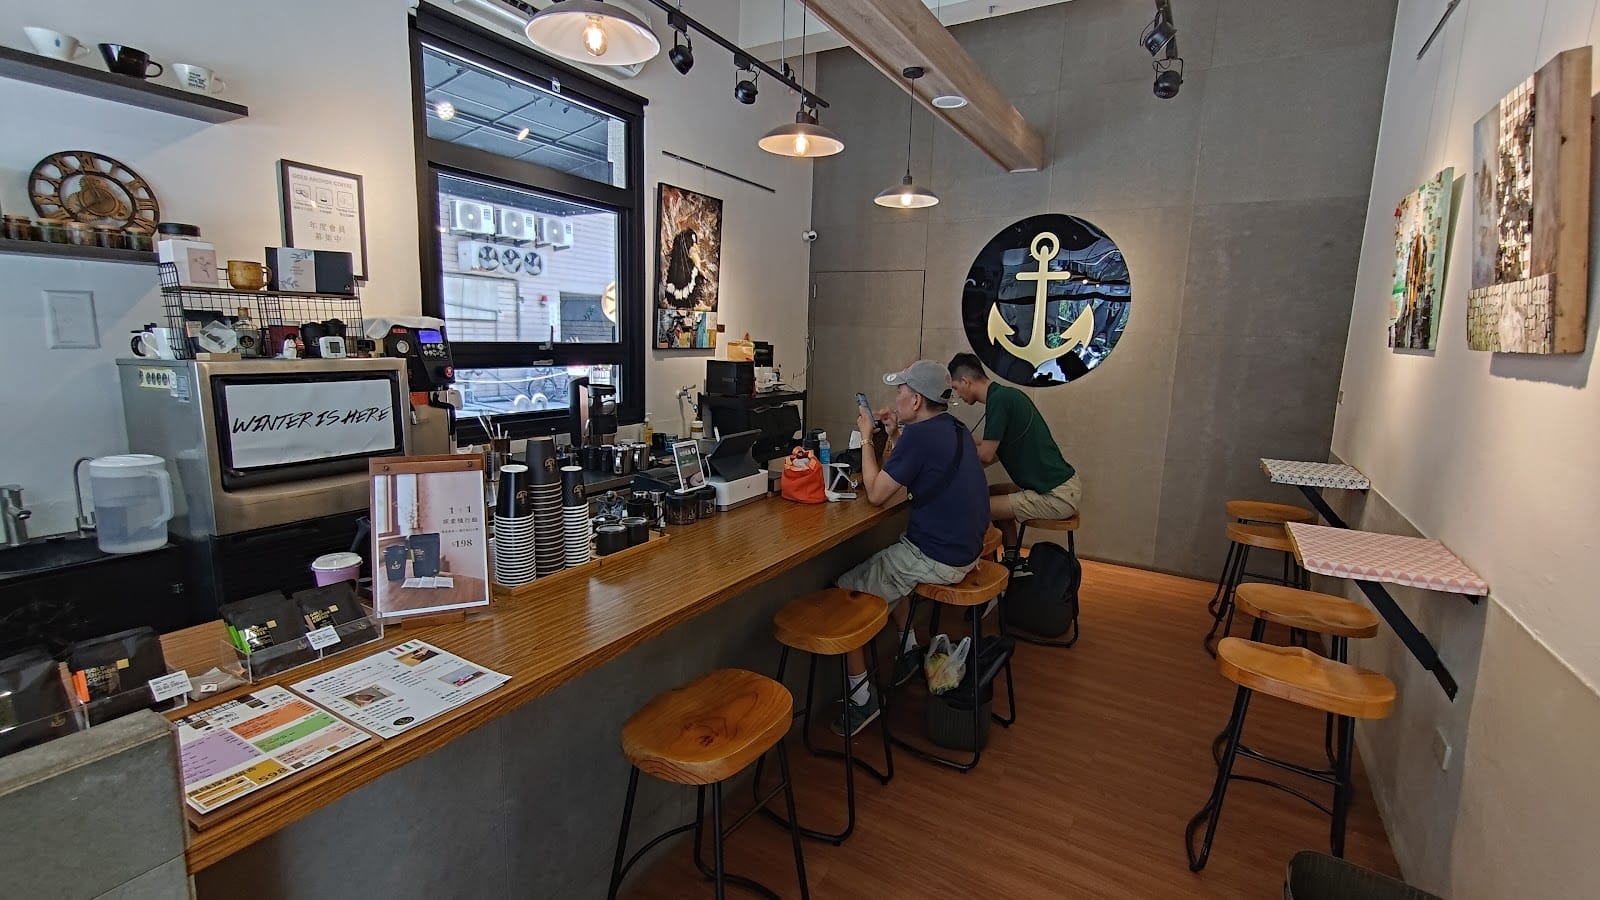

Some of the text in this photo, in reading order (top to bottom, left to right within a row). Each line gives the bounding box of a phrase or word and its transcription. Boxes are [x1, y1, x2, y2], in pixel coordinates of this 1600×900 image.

[232, 405, 392, 434] WINTER IS HERE
[258, 767, 289, 782] 598
